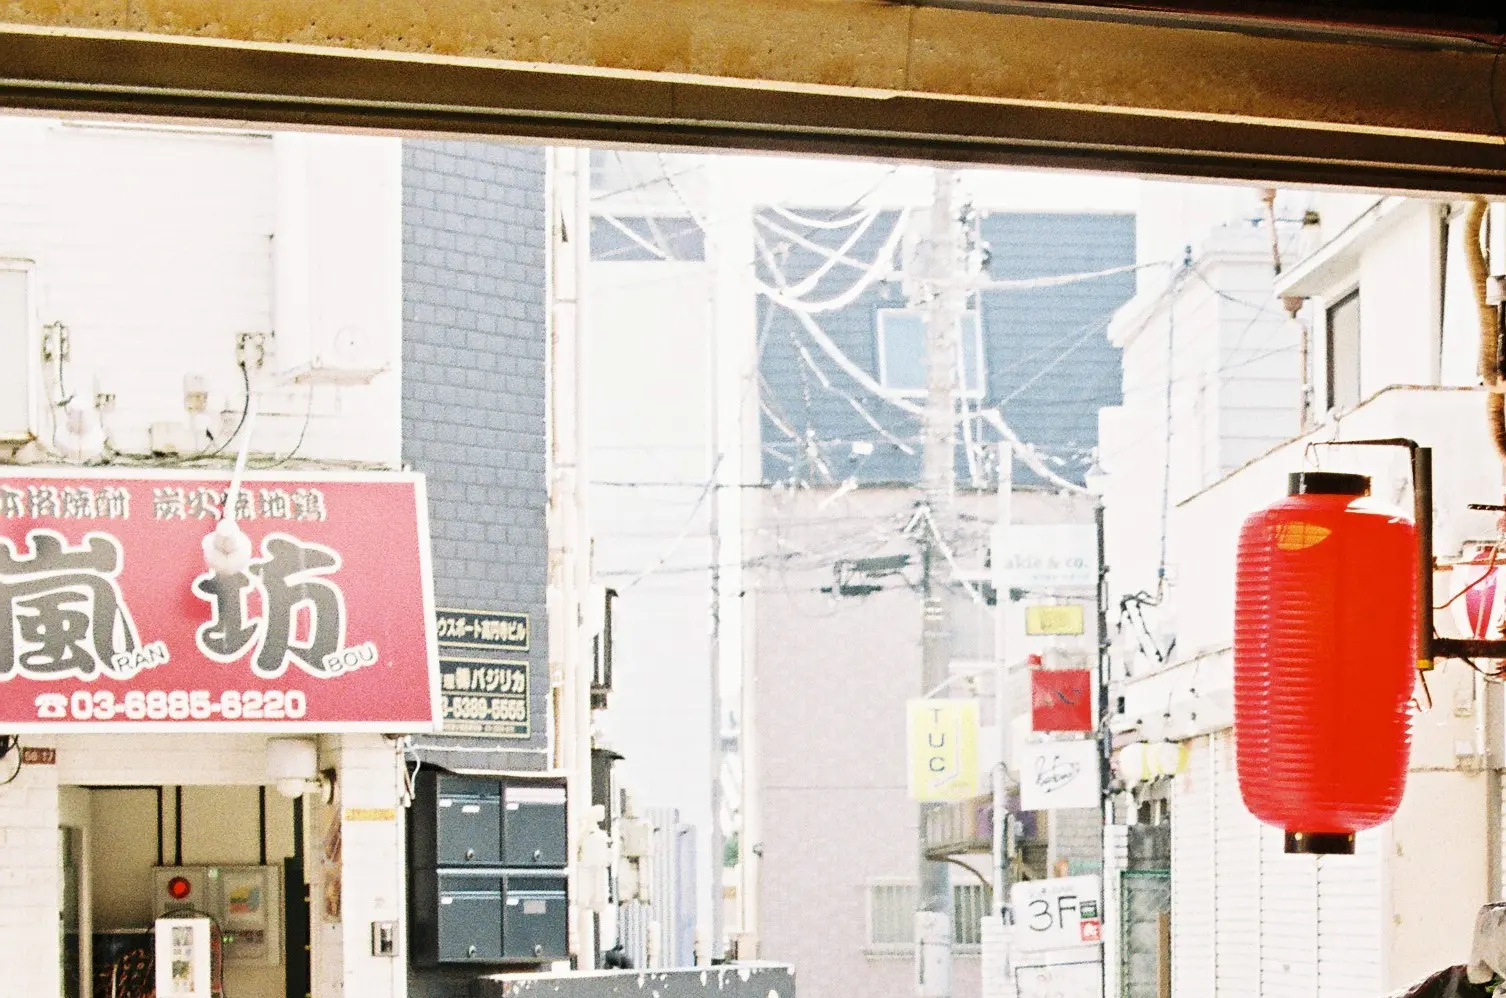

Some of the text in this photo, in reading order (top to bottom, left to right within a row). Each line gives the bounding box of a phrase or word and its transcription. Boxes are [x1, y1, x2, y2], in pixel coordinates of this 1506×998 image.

[115, 648, 166, 672] RAN
[325, 649, 377, 672] BOU
[70, 690, 307, 720] 03-6885-6220
[1028, 895, 1077, 932] 3F
